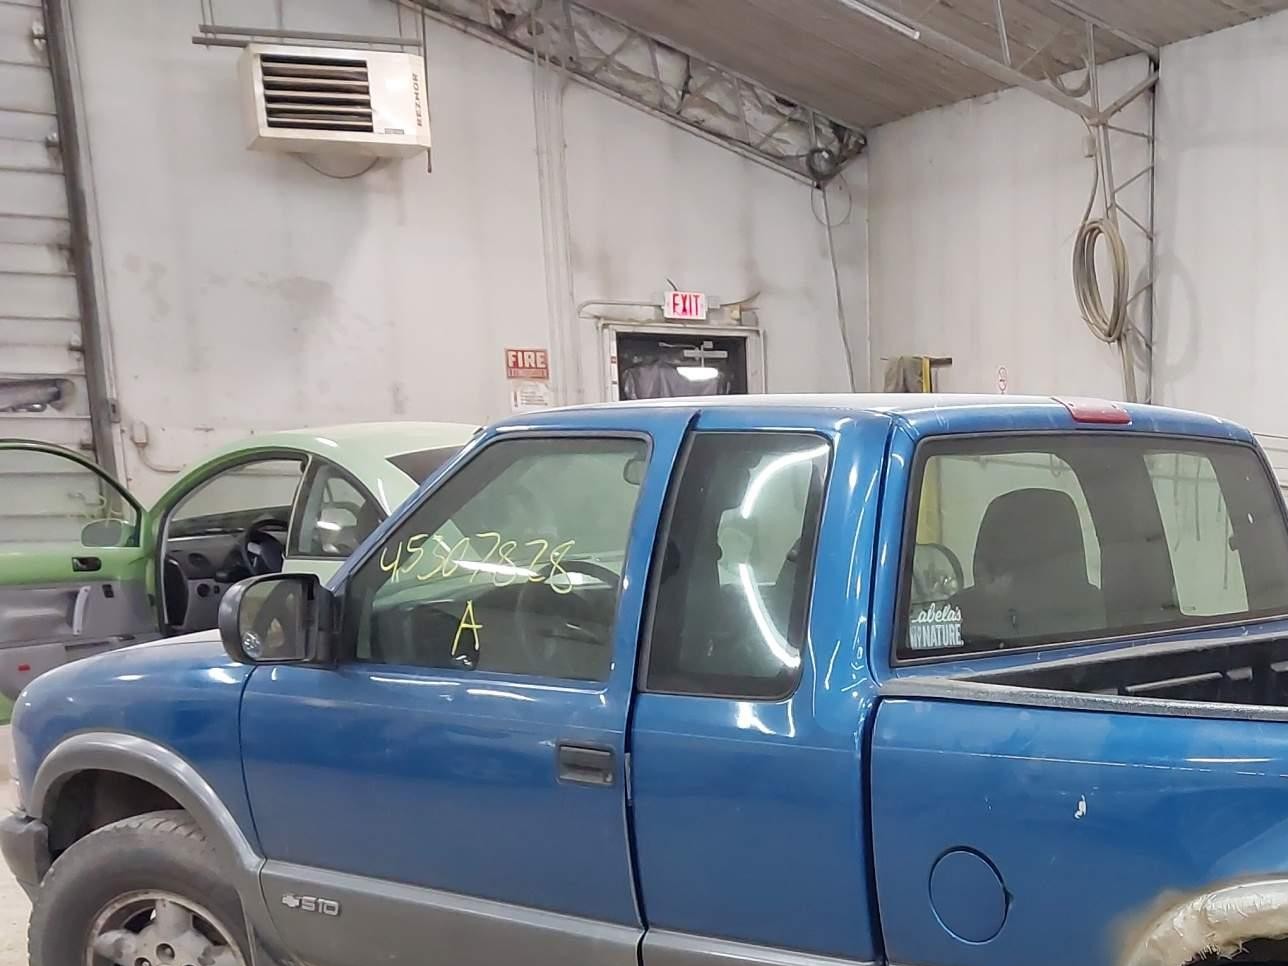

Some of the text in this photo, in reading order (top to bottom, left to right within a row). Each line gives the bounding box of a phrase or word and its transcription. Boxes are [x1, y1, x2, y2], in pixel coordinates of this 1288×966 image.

[673, 293, 700, 316] EXIT
[508, 351, 546, 368] FIRE
[380, 532, 575, 594] 45307828
[911, 602, 961, 623] abela's
[451, 600, 483, 656] A
